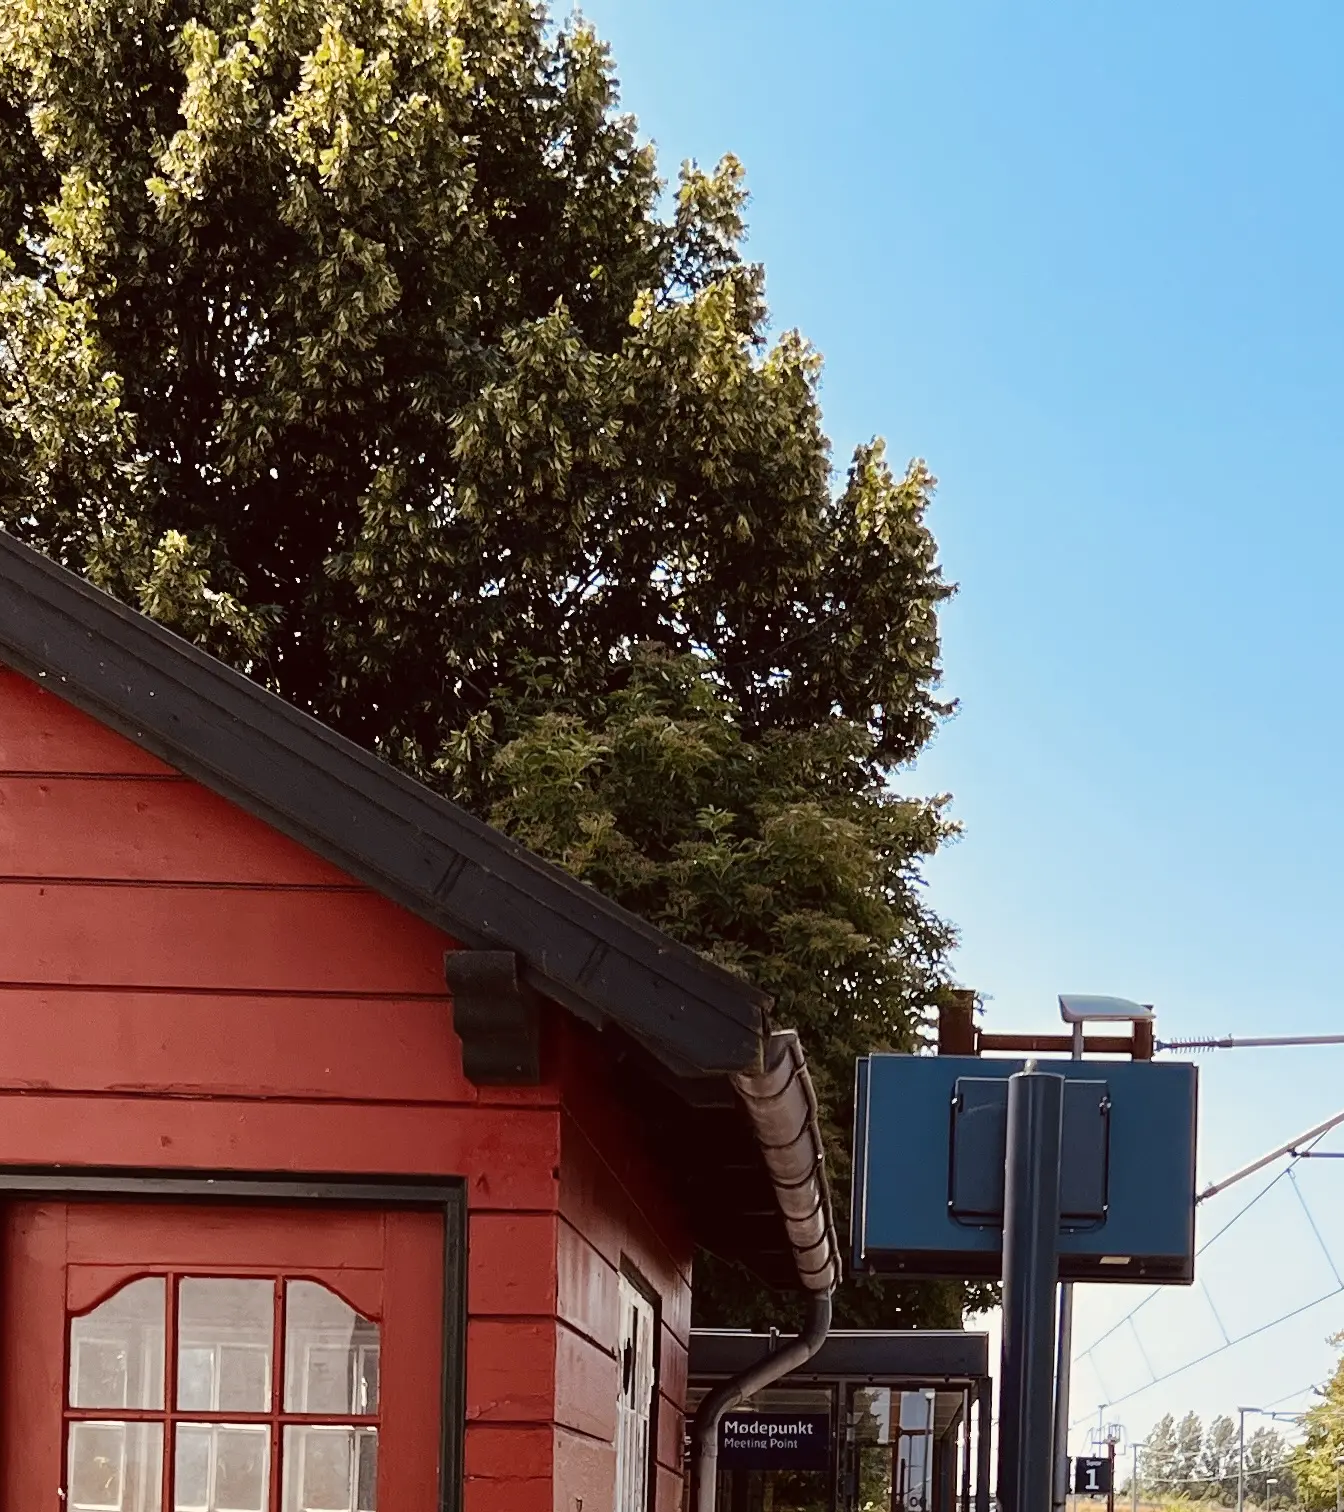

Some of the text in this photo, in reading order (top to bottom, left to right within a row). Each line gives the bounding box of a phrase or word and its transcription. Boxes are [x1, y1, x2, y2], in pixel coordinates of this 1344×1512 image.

[724, 1420, 813, 1437] Mødepunkt
[724, 1437, 798, 1449] Meeting Point
[1085, 1468, 1100, 1490] 1
